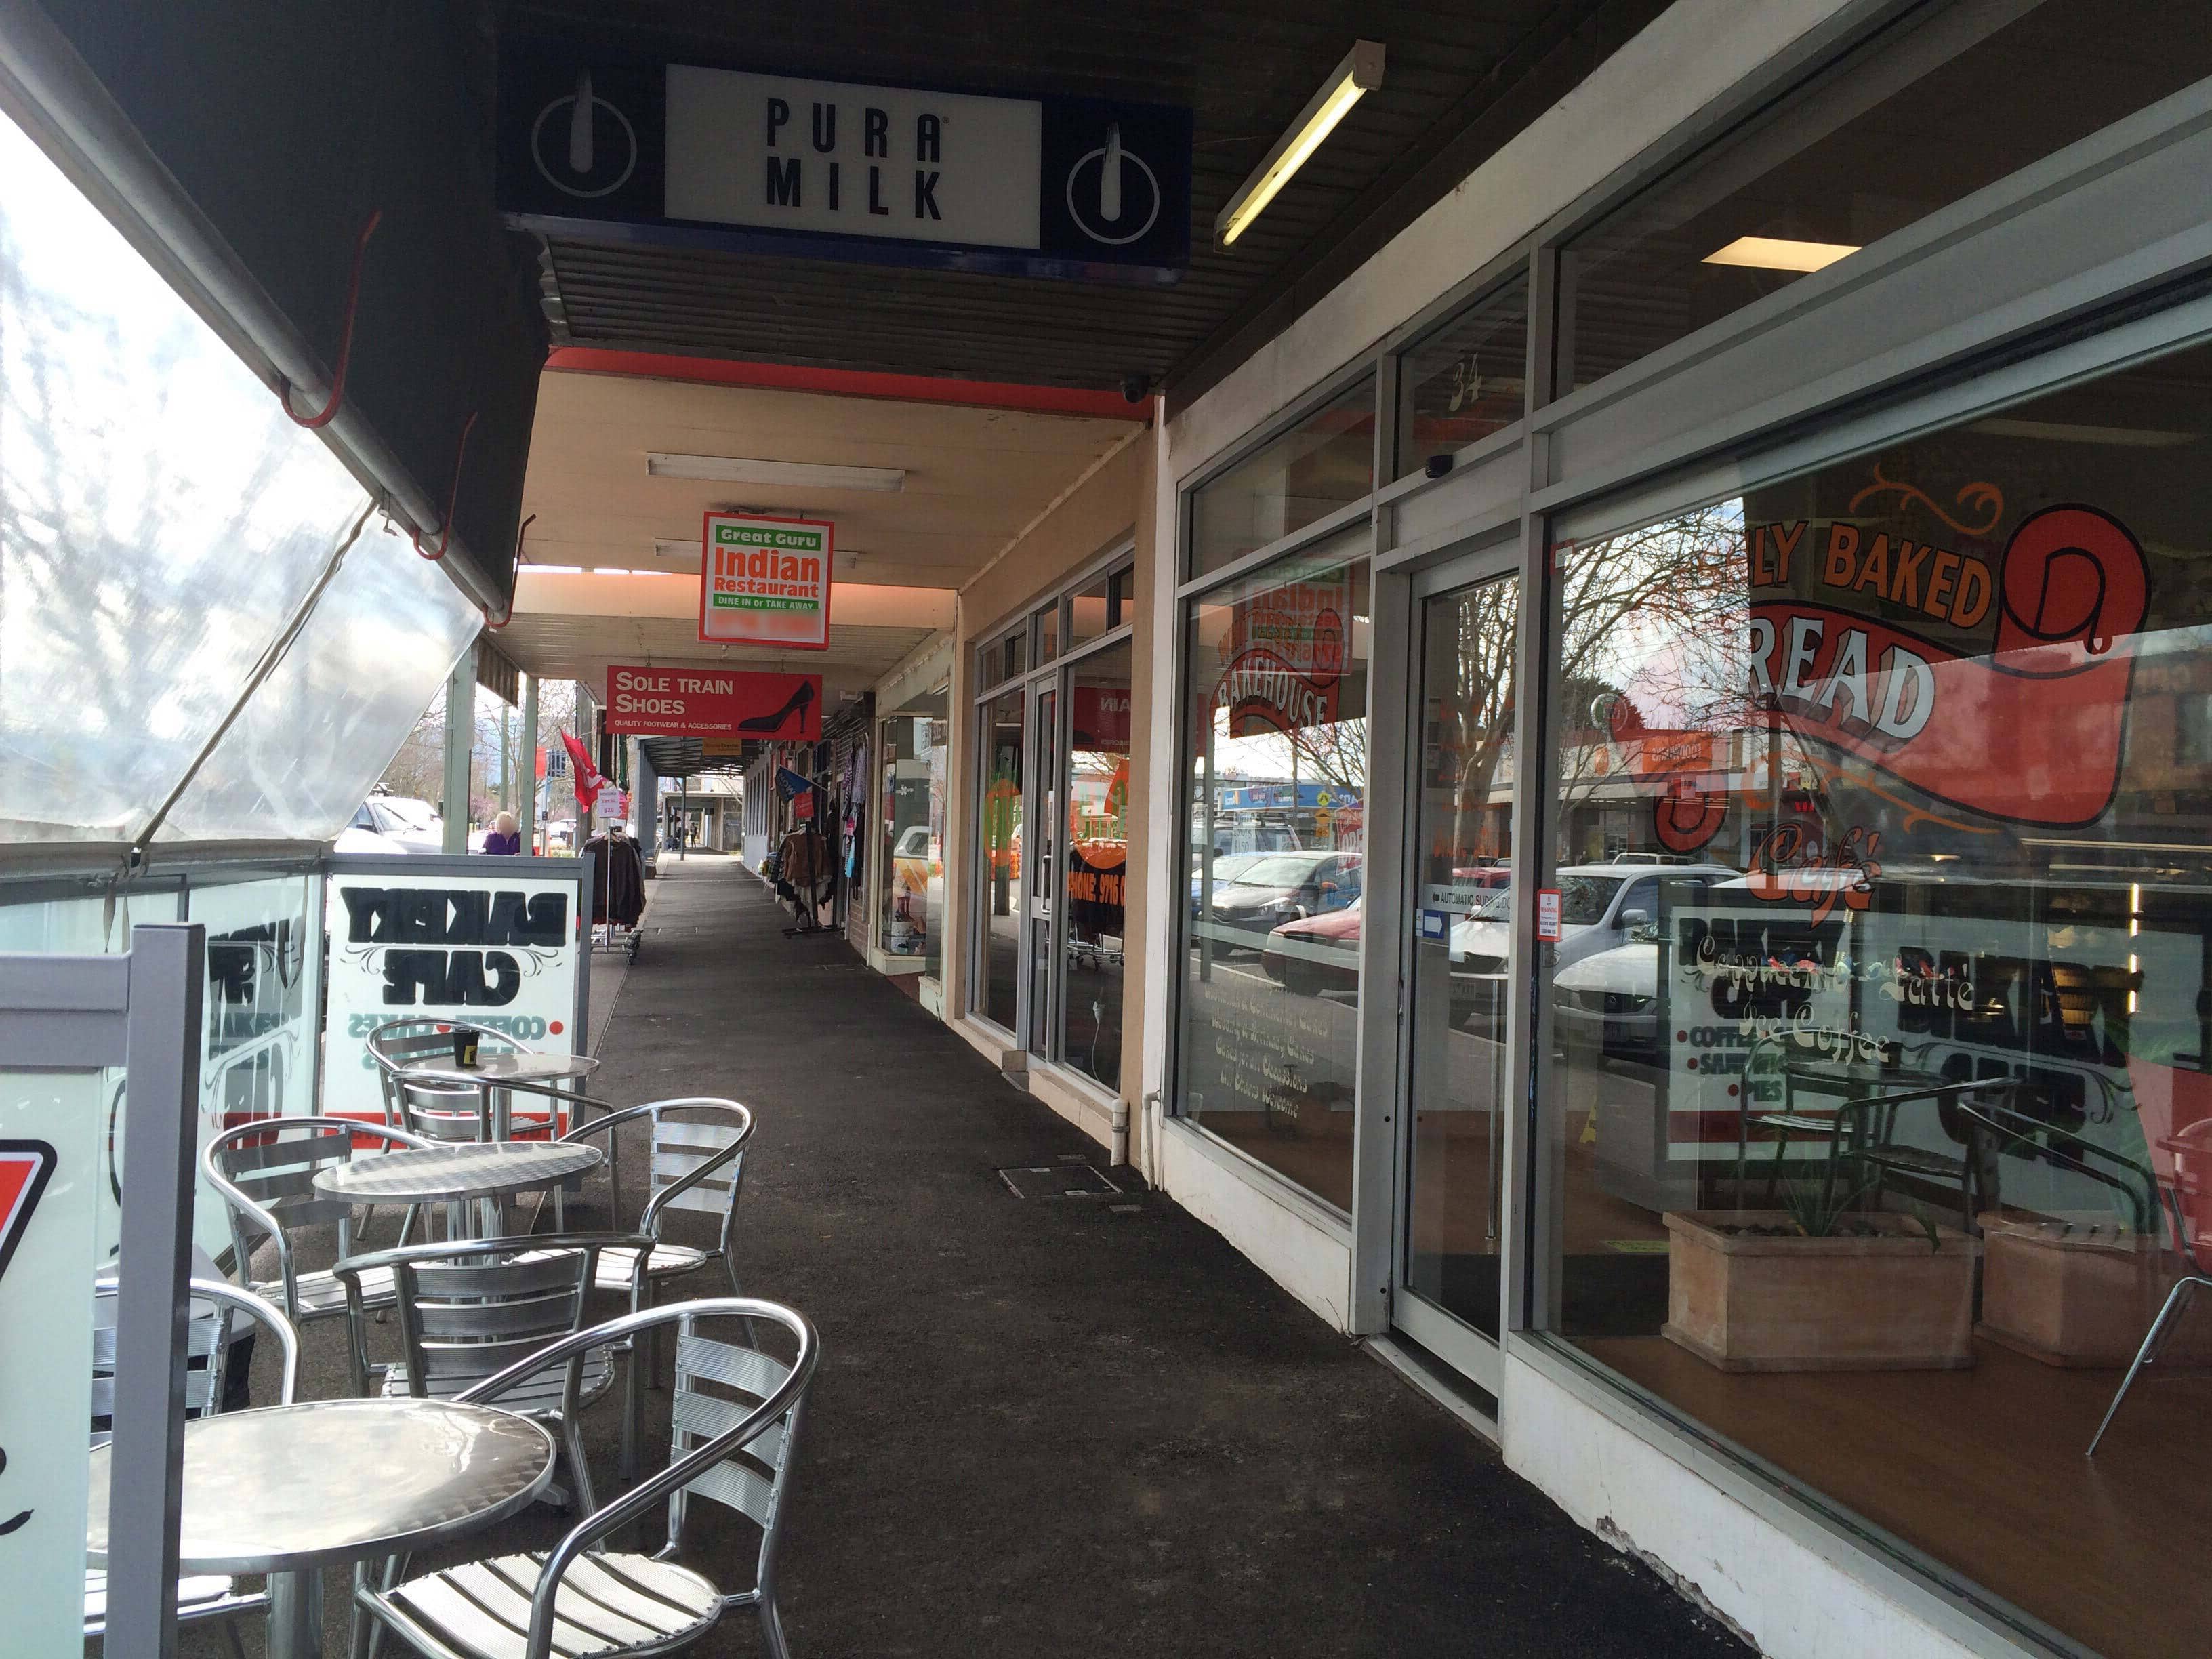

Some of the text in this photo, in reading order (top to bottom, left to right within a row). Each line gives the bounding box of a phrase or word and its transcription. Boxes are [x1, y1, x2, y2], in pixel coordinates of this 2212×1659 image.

[767, 98, 941, 163] PURA
[766, 156, 941, 220] MILK
[1448, 352, 1486, 412] 34
[721, 529, 817, 547] Great Guru
[715, 547, 820, 582] Indian
[1822, 520, 1992, 630] BAKED
[714, 577, 819, 598] Restaurant
[718, 596, 739, 605] DINE
[766, 600, 787, 609] TAKE
[615, 672, 733, 695] SOLE TRAIN
[1218, 656, 1328, 729] BAKEHOUSE
[615, 693, 686, 714] SHOES
[643, 720, 679, 729] FOOTWEAR
[1746, 823, 1882, 931] Café
[1441, 892, 1474, 906] AUTOMATIC
[1879, 954, 1975, 1011] Latté
[1793, 1002, 1890, 1066] Coffee
[1262, 1086, 1299, 1119] Welcome
